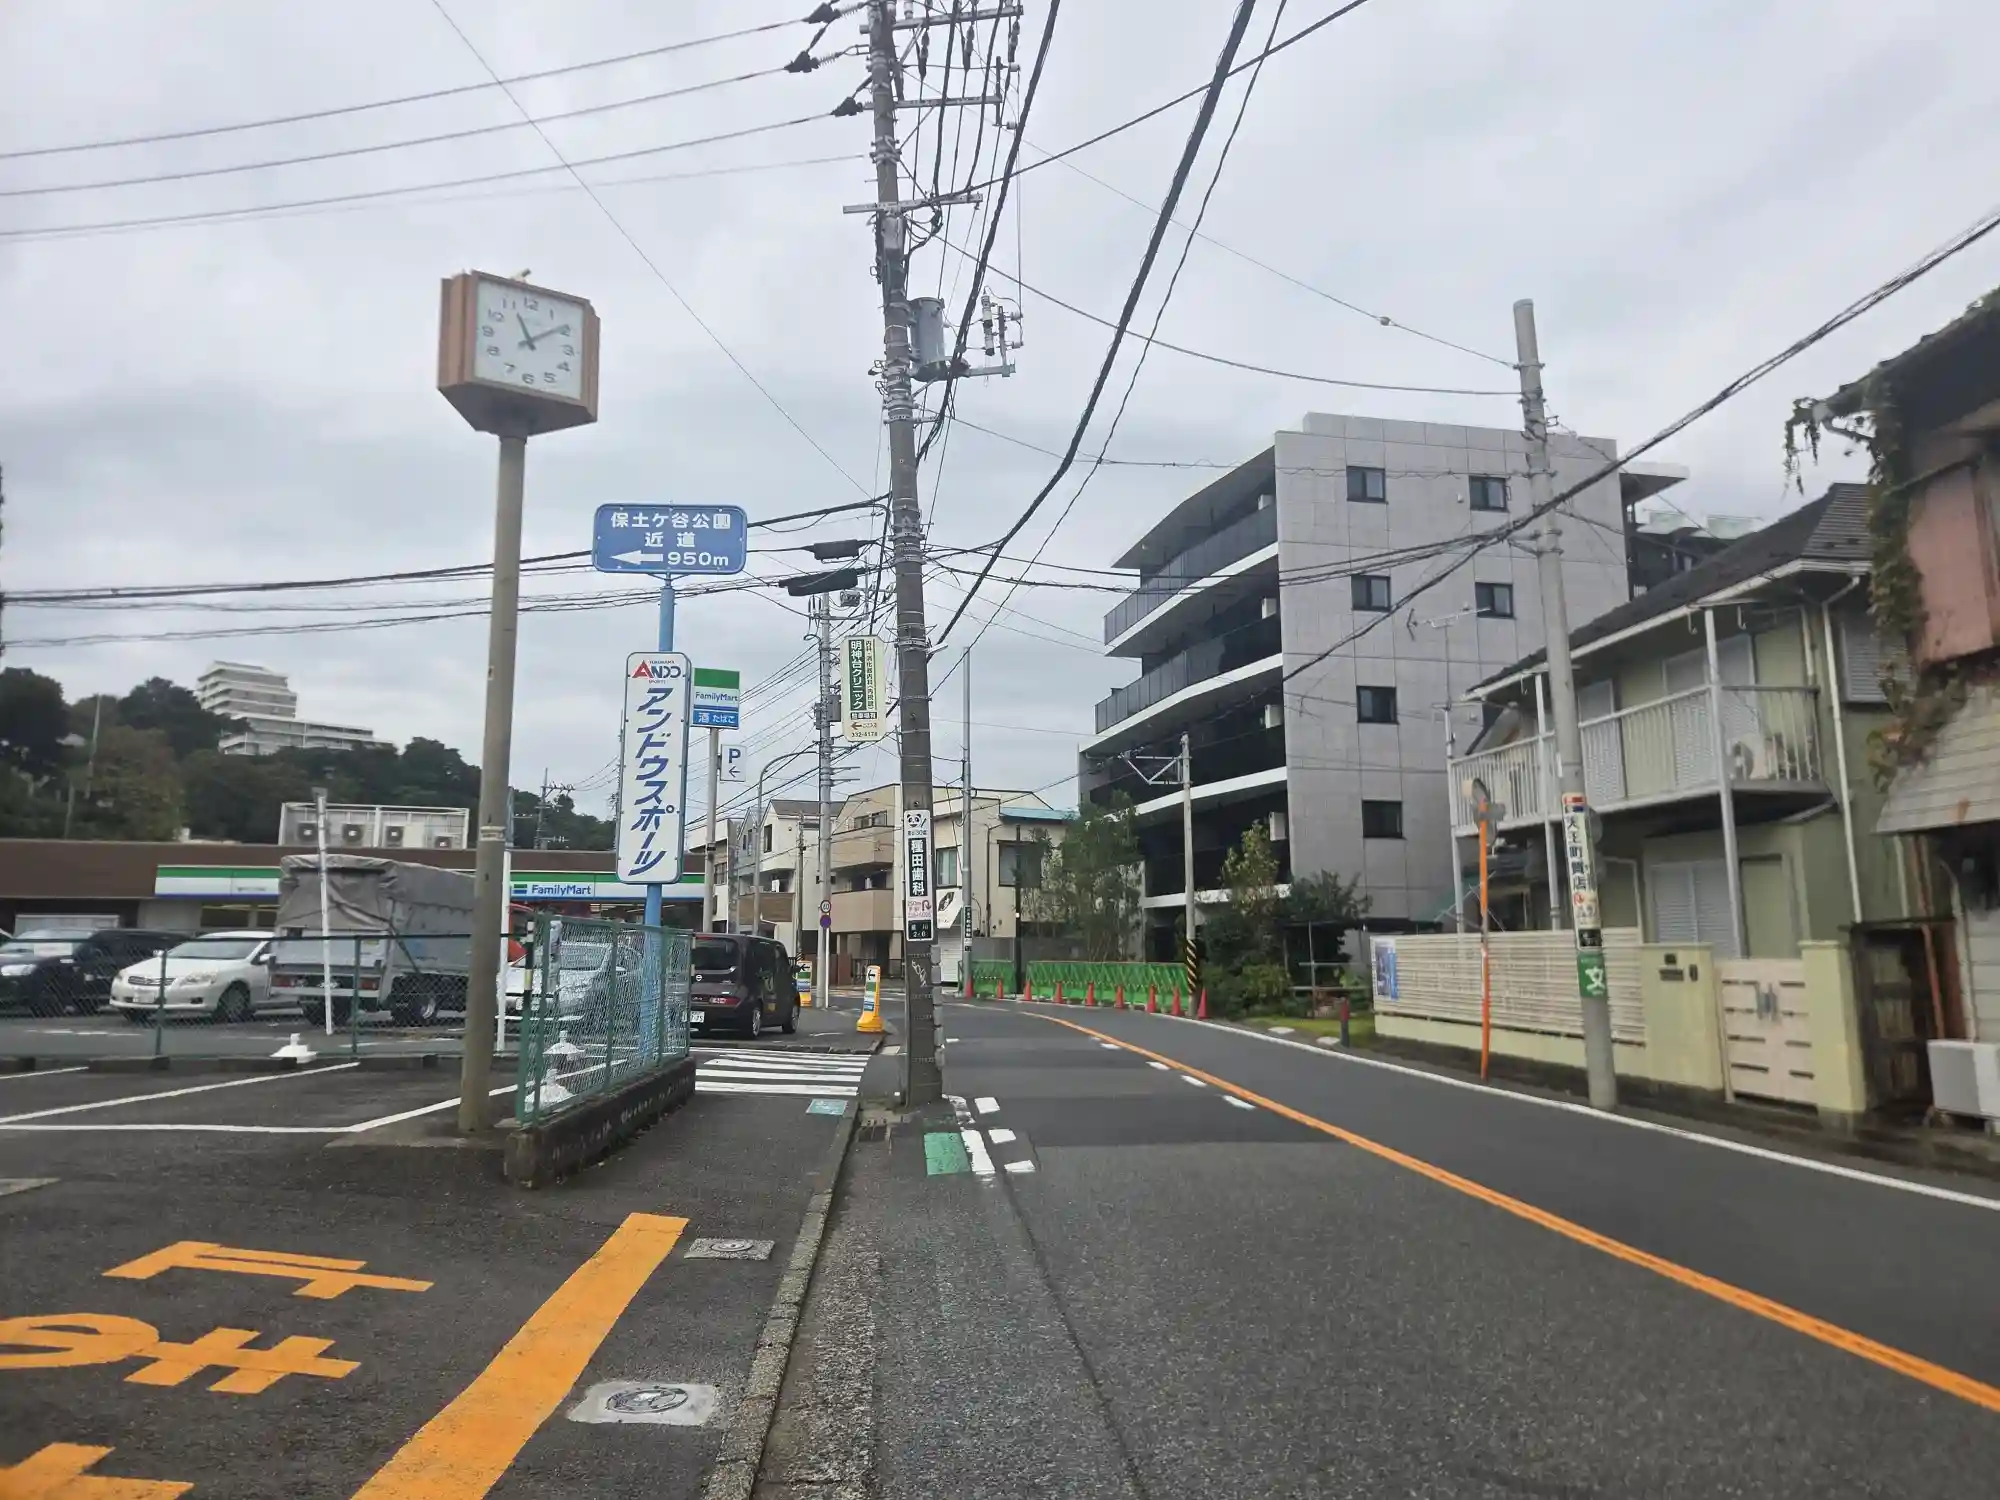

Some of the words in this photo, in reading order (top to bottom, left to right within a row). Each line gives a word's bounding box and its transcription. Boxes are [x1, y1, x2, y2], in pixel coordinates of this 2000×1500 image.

[503, 299, 516, 309] 11
[524, 297, 538, 311] 12
[488, 309, 504, 322] 10
[549, 309, 554, 320] 1
[482, 326, 494, 337] 9
[487, 346, 500, 357] 8
[560, 345, 574, 356] 3
[503, 362, 515, 374] 7
[556, 361, 571, 374] 4
[522, 374, 535, 385] 6
[543, 372, 556, 383] 5
[645, 532, 695, 547] 近道
[667, 552, 729, 566] 950m
[851, 640, 864, 710] 明神台クリニック
[695, 691, 738, 702] FamilyMart
[698, 712, 710, 723] 酒
[712, 714, 735, 724] たばこ
[728, 748, 741, 764] P
[628, 688, 674, 876] アンドウスポーツ
[531, 884, 591, 895] FamilyMart
